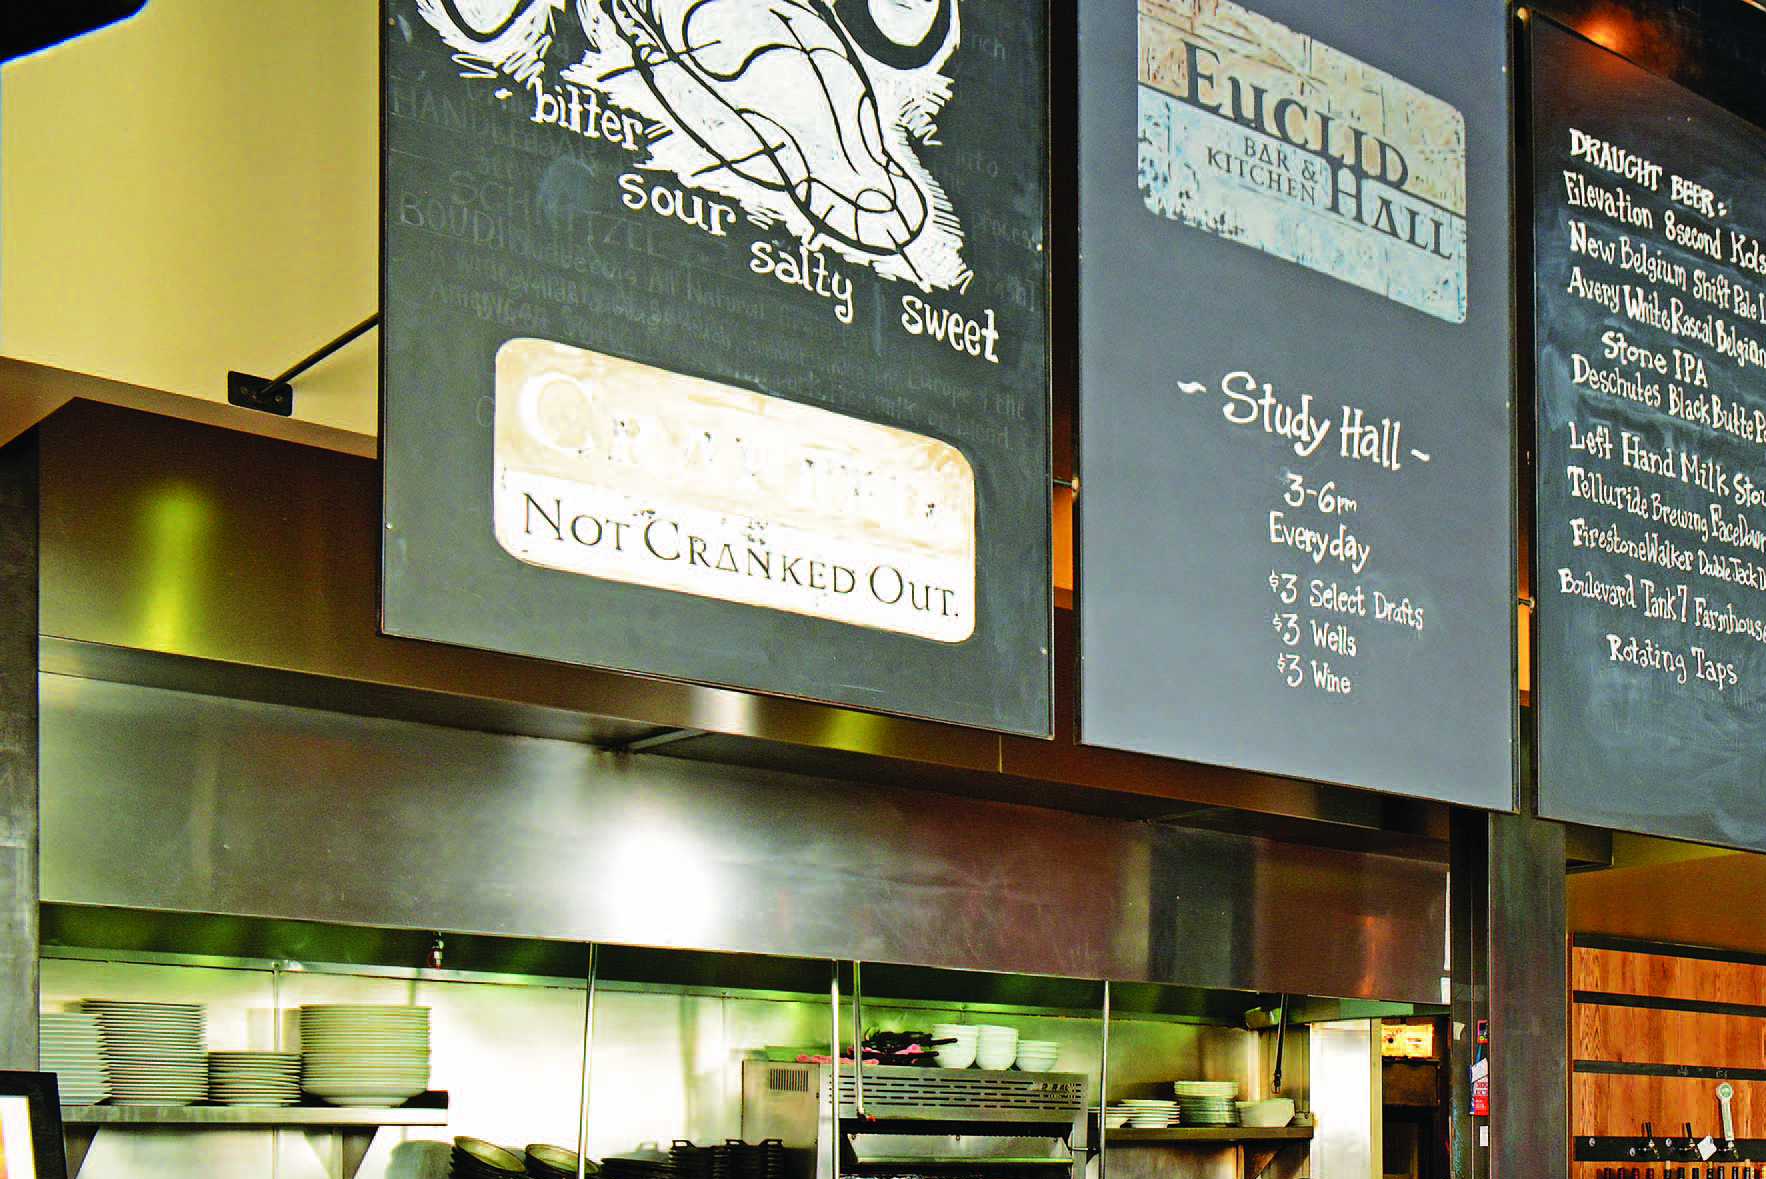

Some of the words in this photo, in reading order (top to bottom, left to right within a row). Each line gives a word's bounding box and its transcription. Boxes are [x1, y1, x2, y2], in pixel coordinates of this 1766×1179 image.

[529, 76, 643, 151] bitter
[1180, 38, 1409, 189] EUCLID
[1207, 147, 1316, 206] KITCHEN
[1244, 136, 1291, 172] BAR
[1301, 160, 1318, 184] &
[1569, 128, 1662, 191] DRAUGHT
[618, 172, 737, 239] sour
[1325, 155, 1452, 260] HALL
[1563, 170, 1653, 230] Elevation
[749, 240, 854, 324] salty
[1568, 219, 1615, 264] New
[1619, 236, 1687, 292] Belgium
[1693, 269, 1731, 309] Shift
[1733, 284, 1757, 320] Pale
[901, 295, 1000, 363] sweet
[1567, 266, 1620, 314] Avery
[1622, 284, 1671, 331] White
[1670, 297, 1714, 347] Rascal
[1715, 320, 1766, 367] Belgian
[1601, 331, 1668, 375] Stone
[1673, 349, 1708, 388] IPA
[1221, 371, 1331, 457] Study
[1340, 405, 1401, 471] Hall
[1571, 353, 1661, 407] Deschutes
[1668, 383, 1711, 424] Black
[1711, 394, 1754, 440] Butte
[1568, 421, 1613, 460] Left
[1621, 431, 1676, 478] Hand
[1680, 452, 1730, 496] Milk
[1567, 465, 1649, 519] Telluride
[1650, 492, 1709, 543] Brewing
[1710, 503, 1740, 547] Face
[522, 491, 630, 551] NOT
[643, 519, 856, 596] CRANKED
[869, 564, 959, 618] OUT.
[1269, 511, 1370, 574] Everyday
[1569, 517, 1647, 561] Firestone
[1645, 531, 1694, 571] Walker
[1729, 557, 1758, 588] Jack
[1268, 569, 1297, 604] $3
[1309, 579, 1366, 616] Select
[1373, 590, 1424, 630] Drafts
[1557, 567, 1637, 609] Boulevard
[1640, 579, 1677, 621] Tank
[1677, 584, 1687, 622] 7
[1272, 613, 1300, 645] $3
[1309, 619, 1357, 657] Wells
[1606, 633, 1688, 684] Rotating
[1690, 646, 1738, 690] Taps
[1277, 652, 1303, 687] $3
[1310, 660, 1351, 694] Wine
